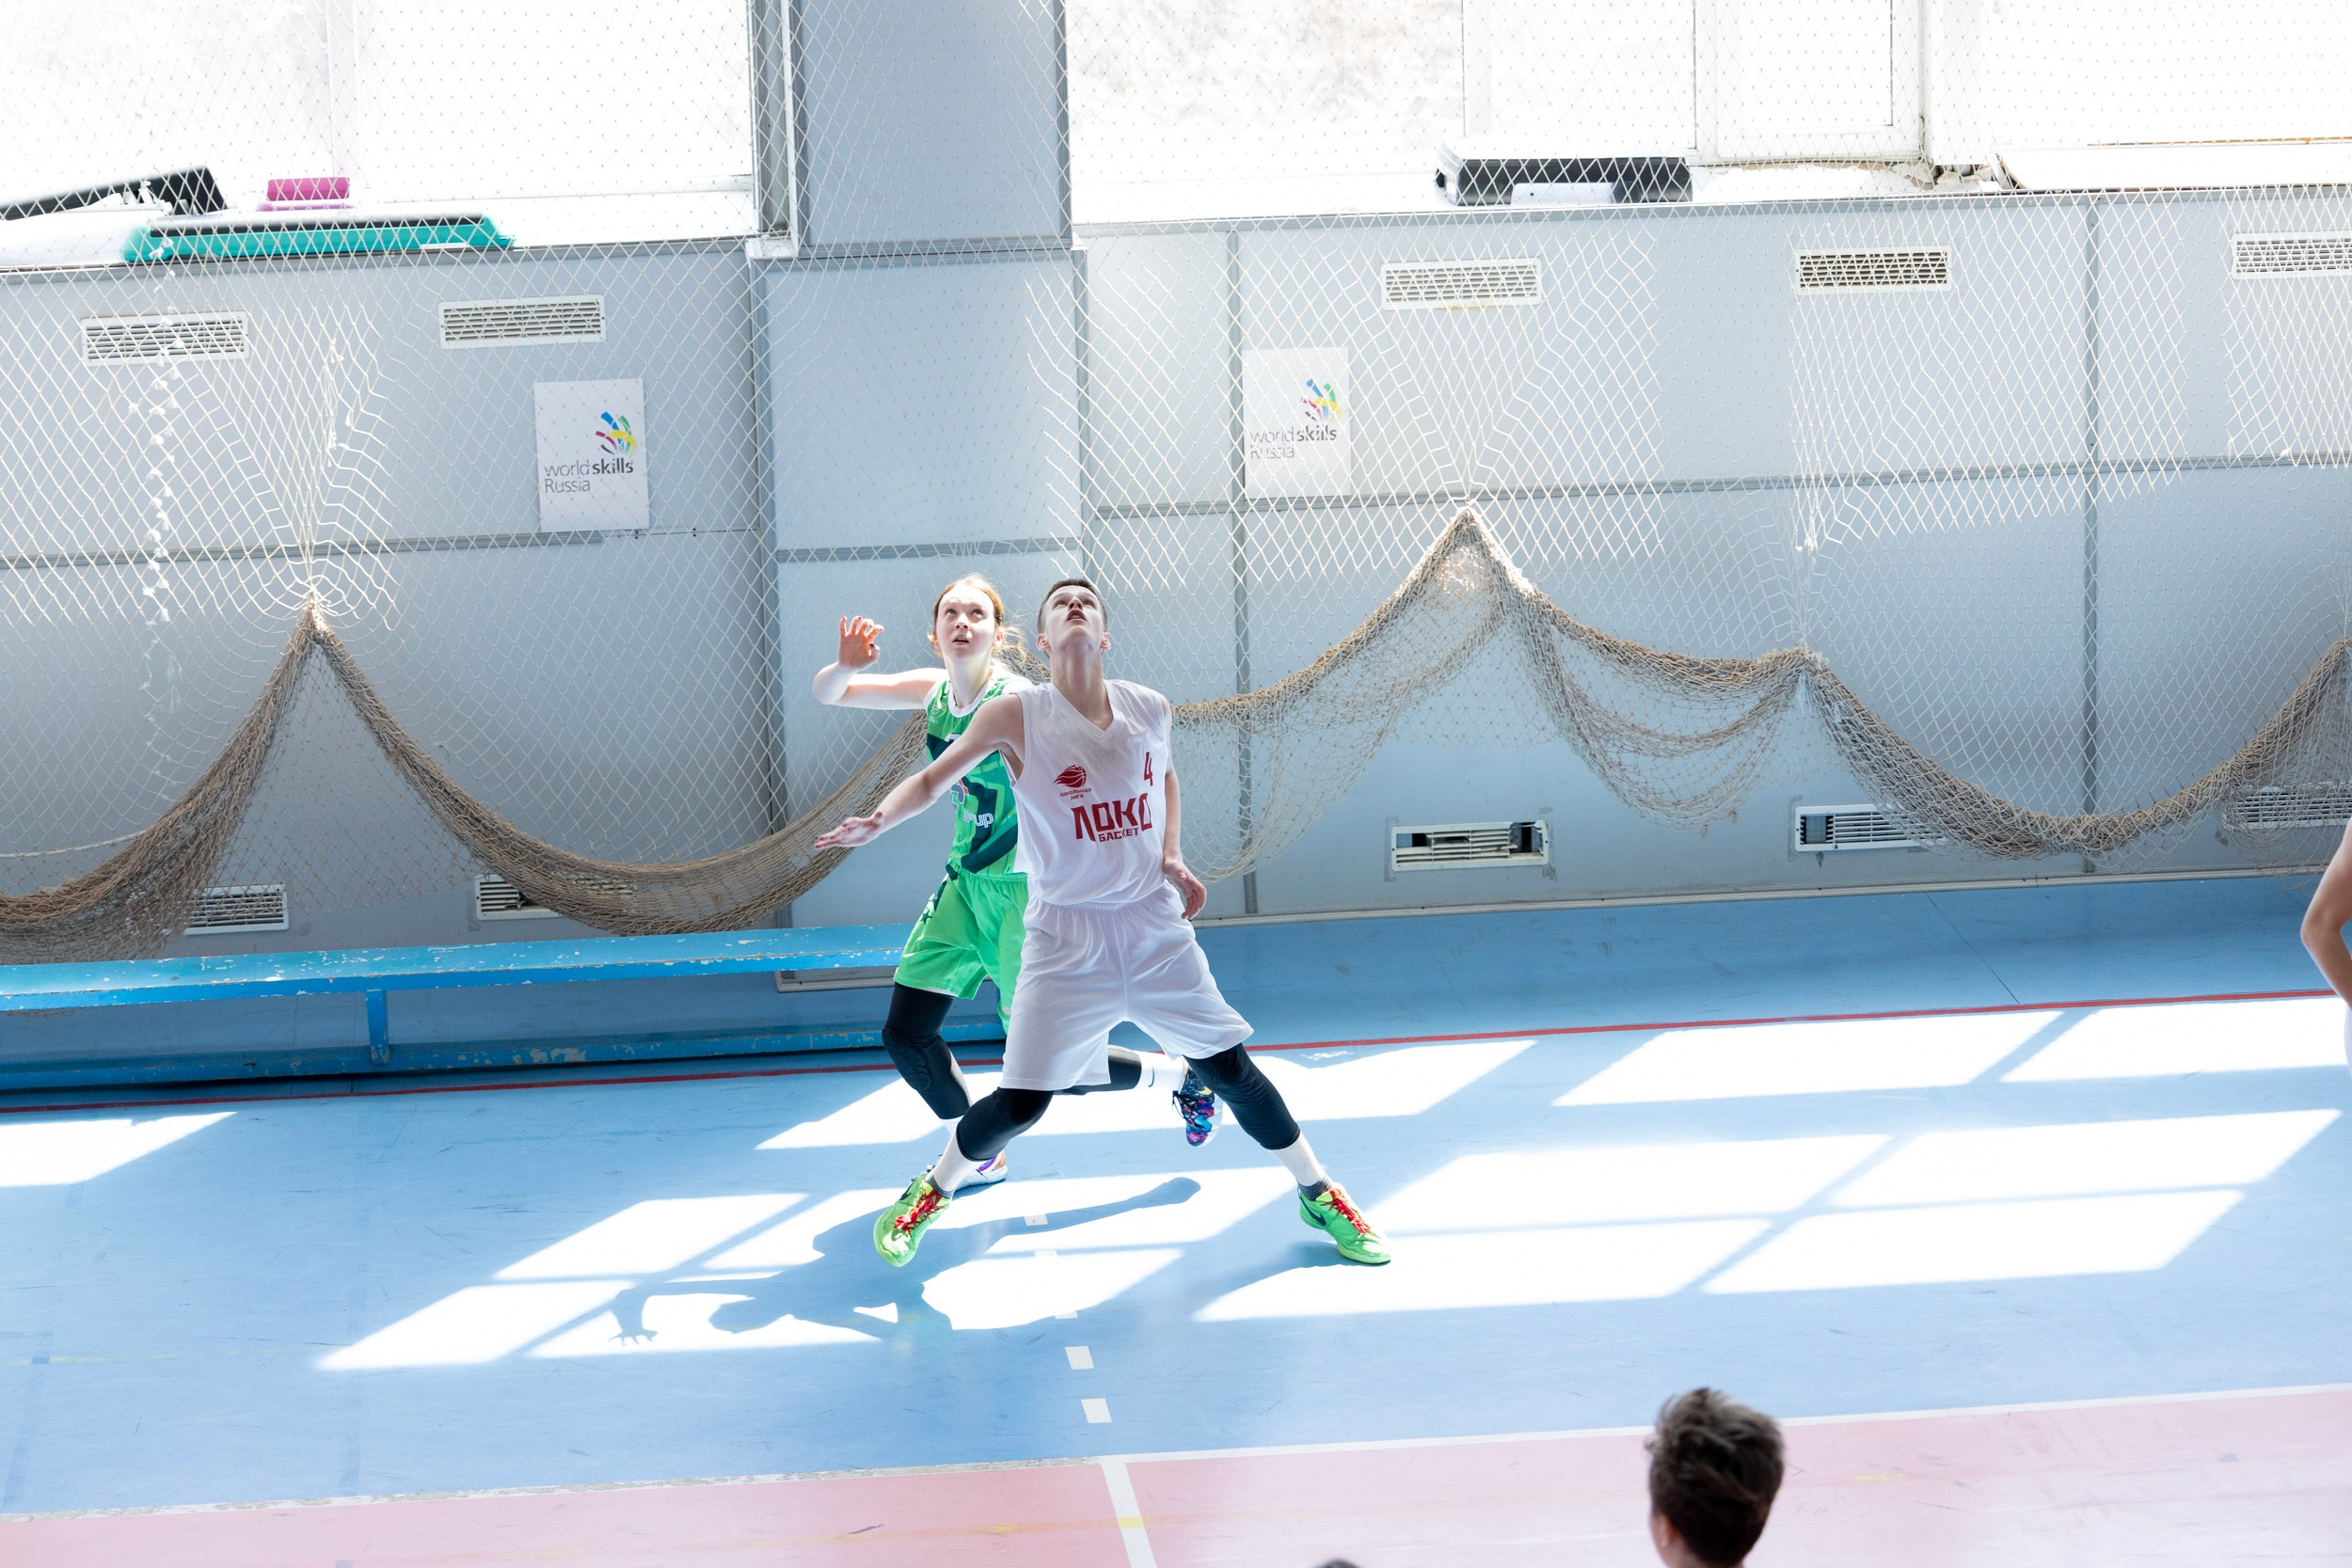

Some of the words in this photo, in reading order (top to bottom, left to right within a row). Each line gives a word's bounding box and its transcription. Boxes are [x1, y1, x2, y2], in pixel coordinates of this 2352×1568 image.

[545, 477, 591, 493] Russia
[1144, 752, 1153, 786] 4
[1098, 827, 1139, 842] БАСКЕТ
